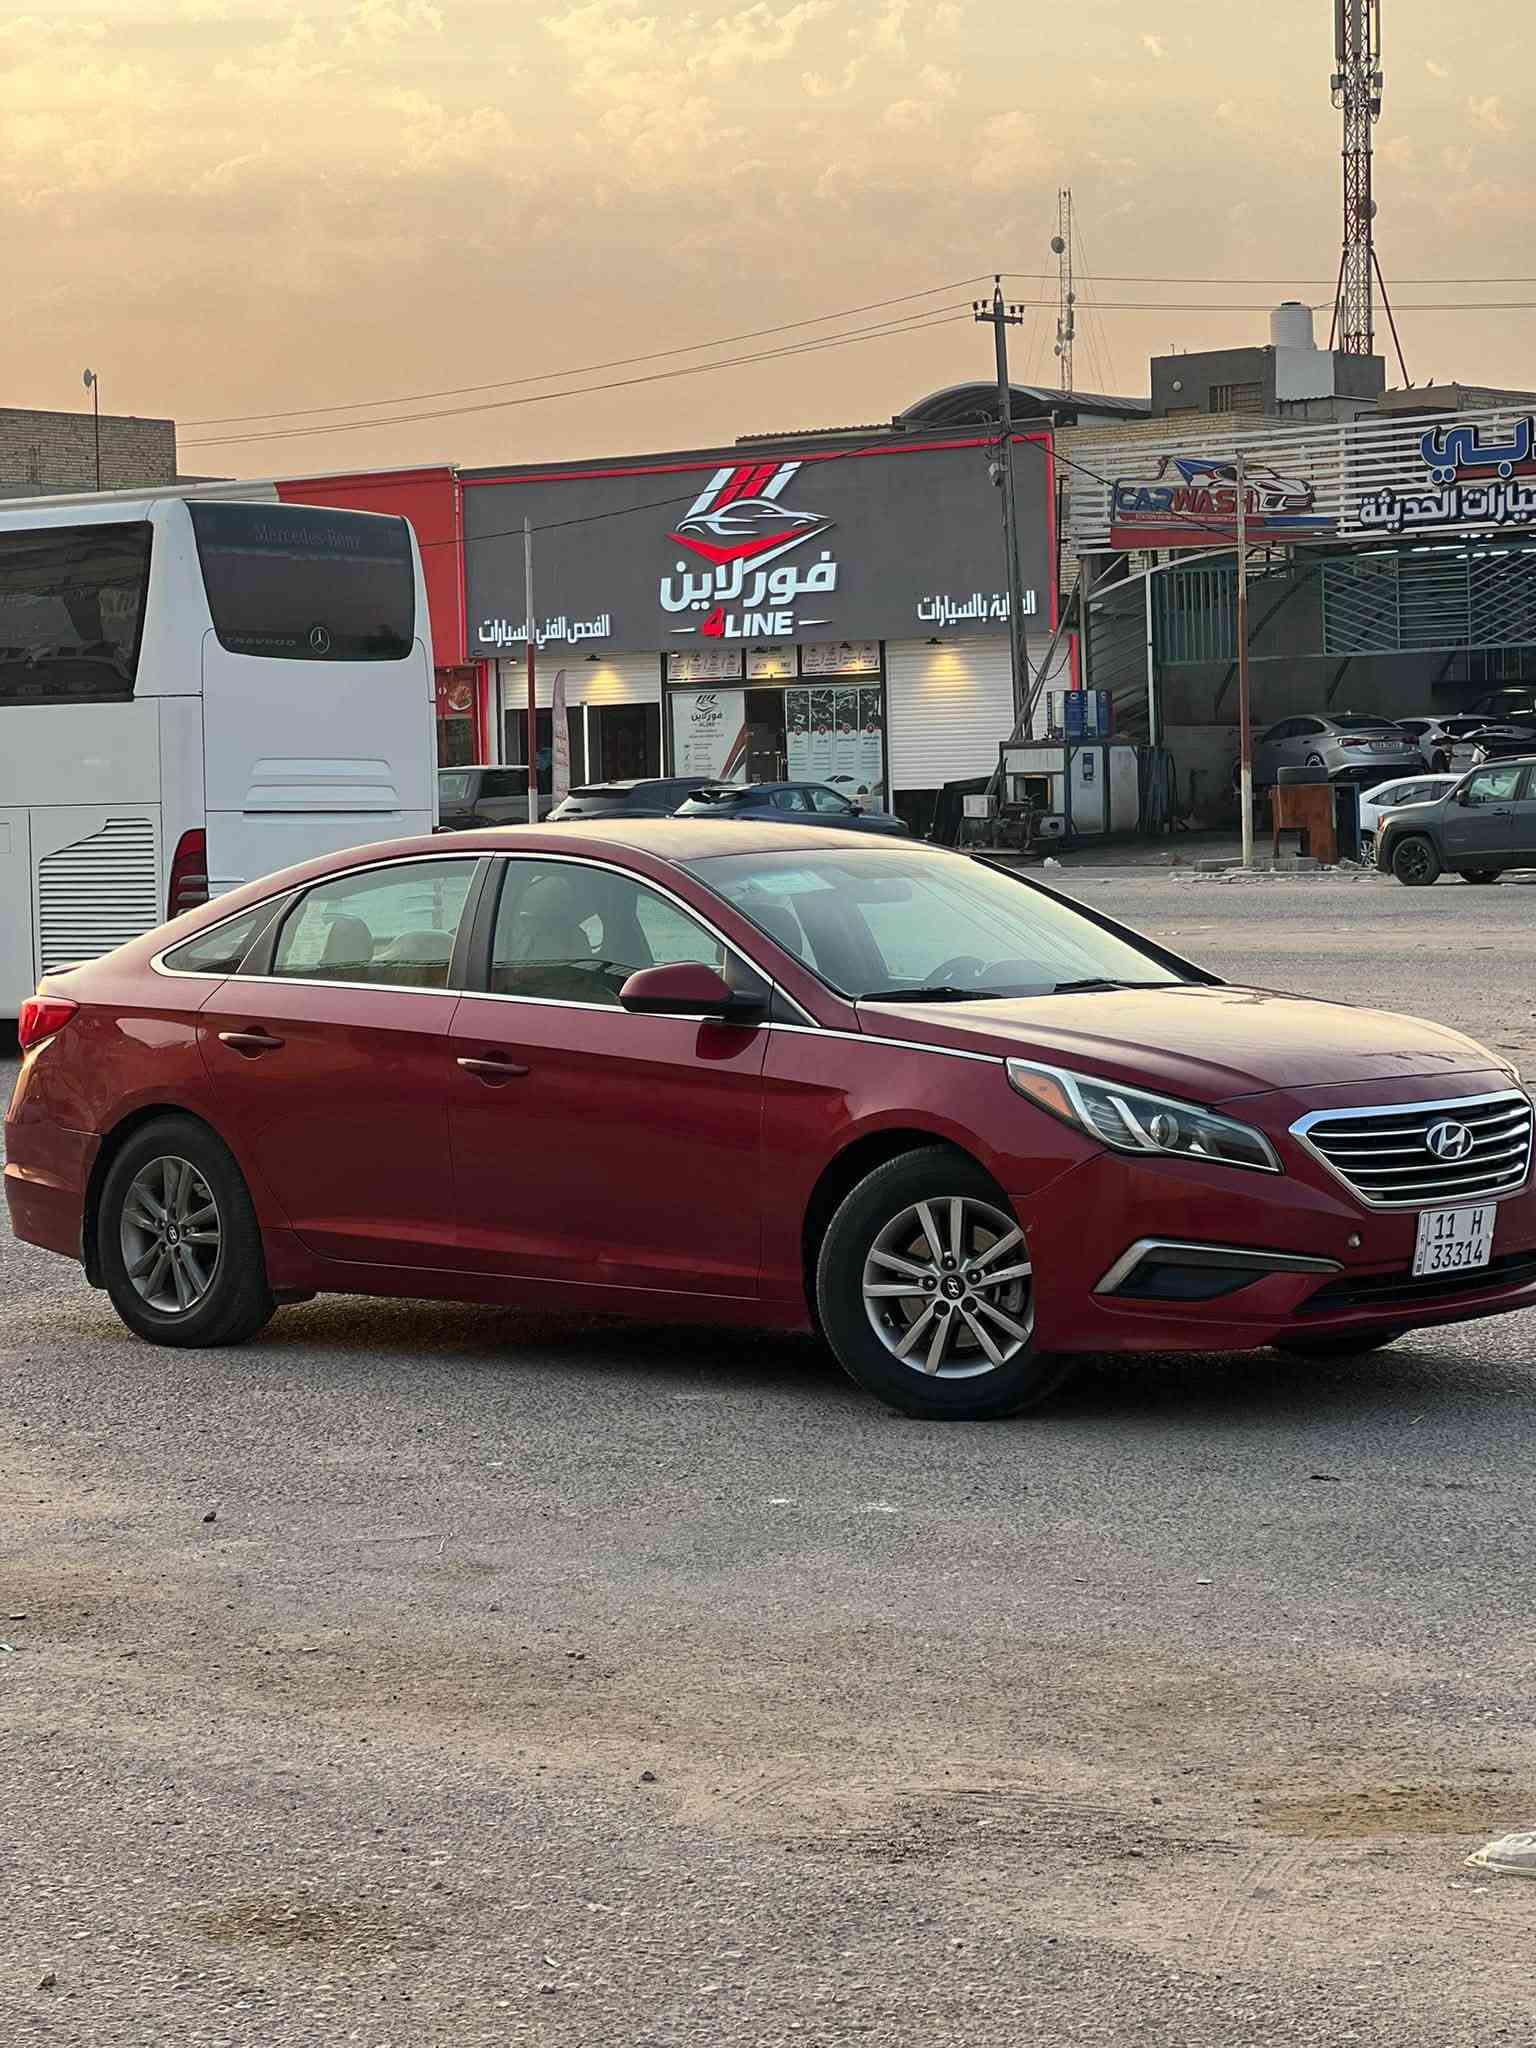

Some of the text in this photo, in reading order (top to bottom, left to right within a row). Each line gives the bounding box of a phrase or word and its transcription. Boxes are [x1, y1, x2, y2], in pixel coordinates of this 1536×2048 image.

[1420, 417, 1536, 484] بي
[1360, 482, 1536, 529] يارات الحديثة
[254, 522, 361, 549] Mercedes-Benz
[917, 590, 1036, 627] الاية بالسيارات
[535, 616, 566, 650] الفني
[567, 614, 610, 644] الفحص
[1434, 1213, 1456, 1240] 11
[1471, 1209, 1483, 1235] H
[1431, 1239, 1483, 1269] 33314
